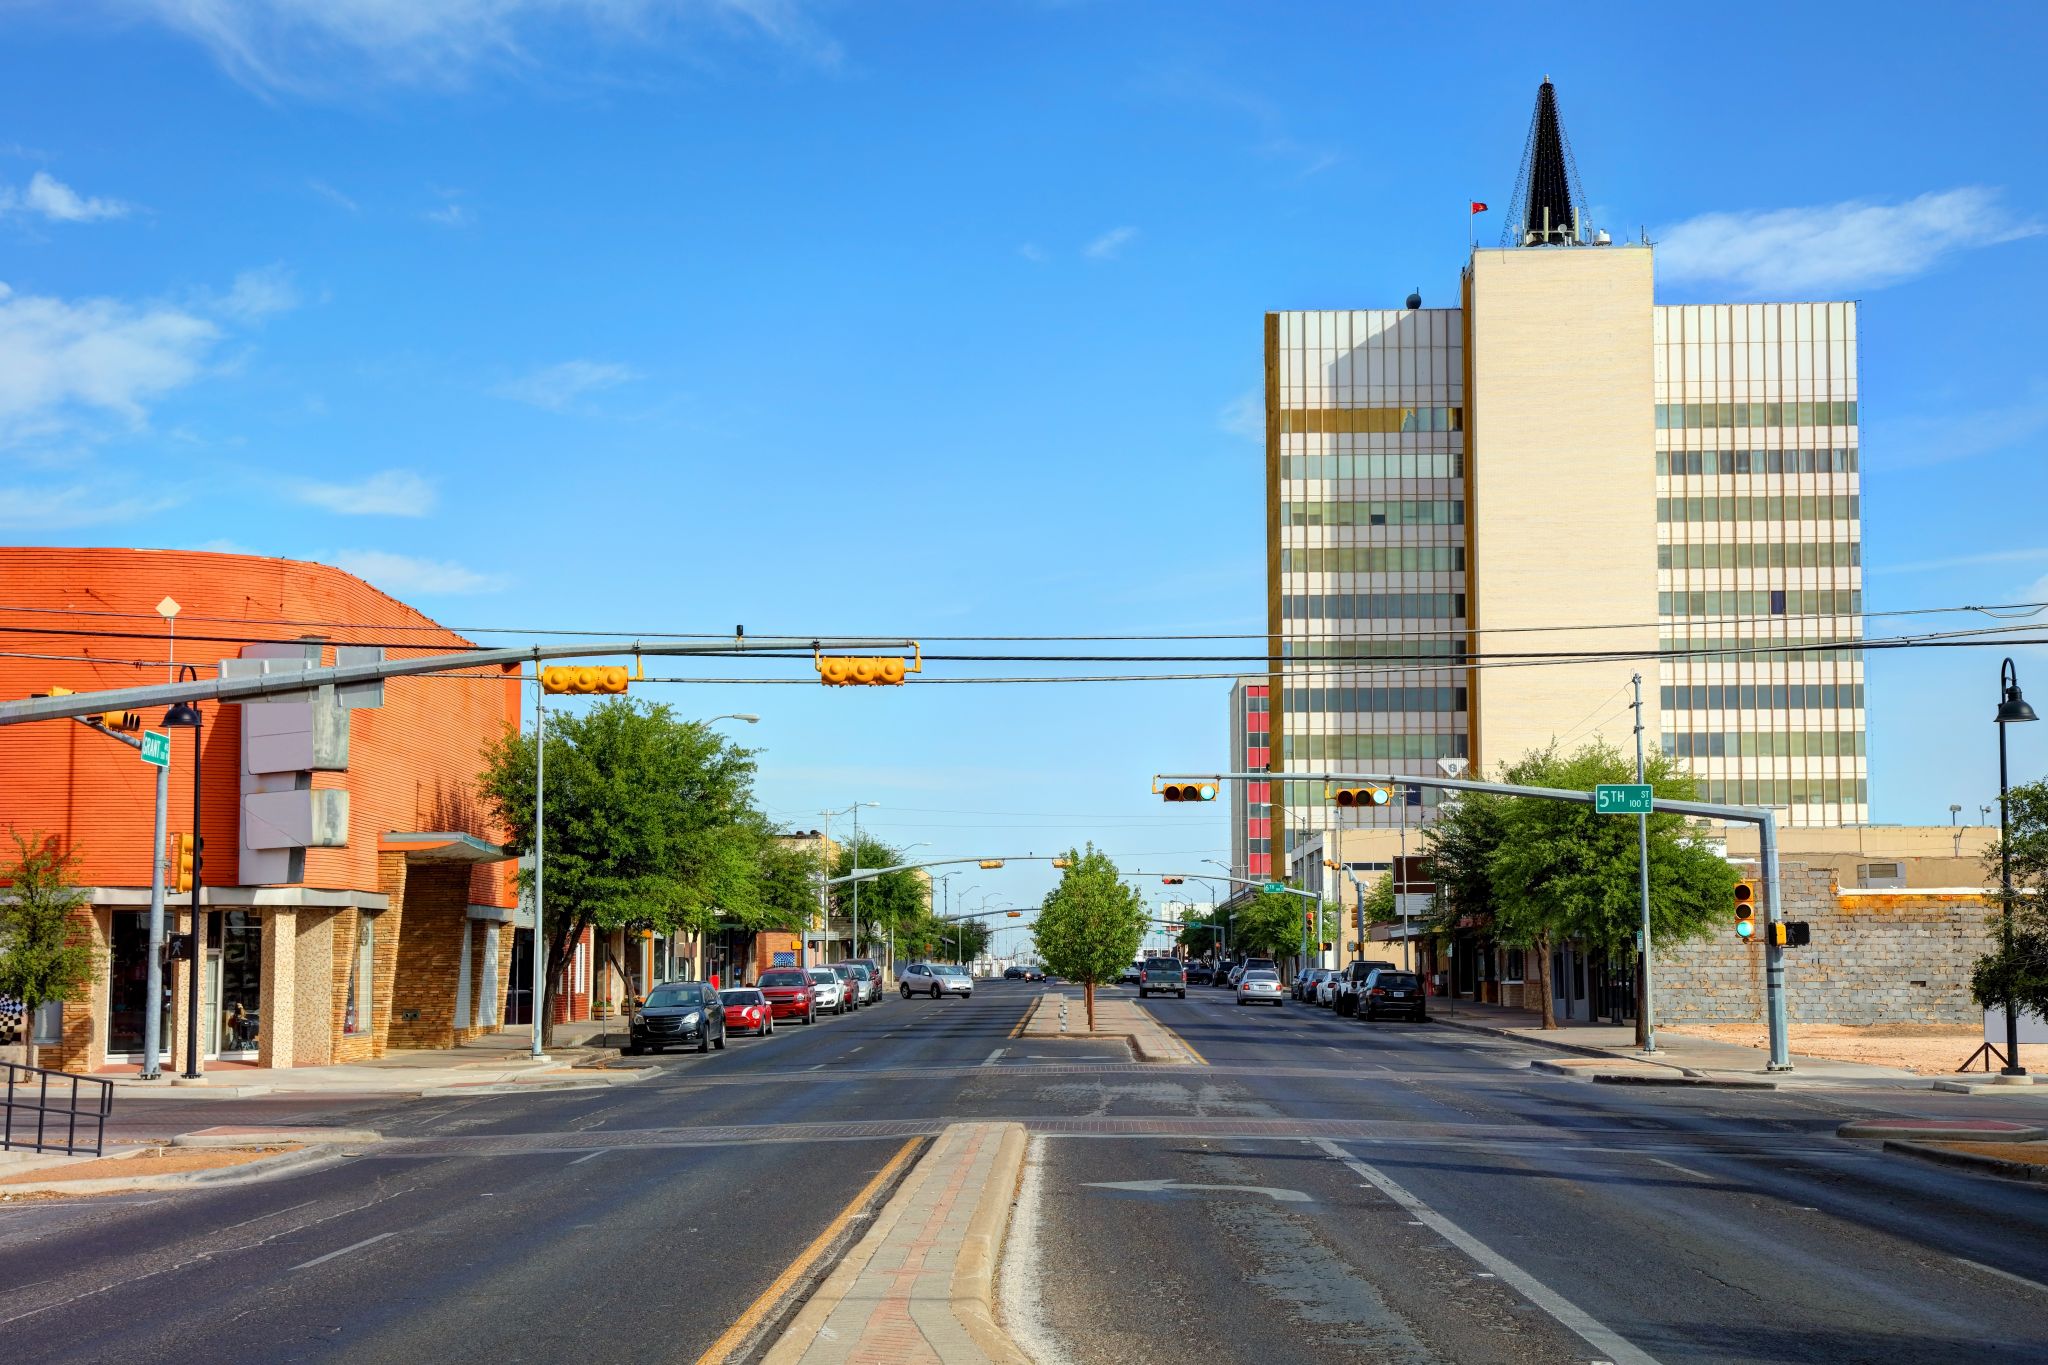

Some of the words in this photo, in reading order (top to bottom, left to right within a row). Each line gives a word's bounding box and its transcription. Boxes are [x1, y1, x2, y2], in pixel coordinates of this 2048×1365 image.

[143, 736, 161, 758] GRANT
[1599, 790, 1625, 808] 5TH
[1640, 790, 1650, 799] ST
[1629, 799, 1642, 808] 100
[1645, 800, 1650, 808] E
